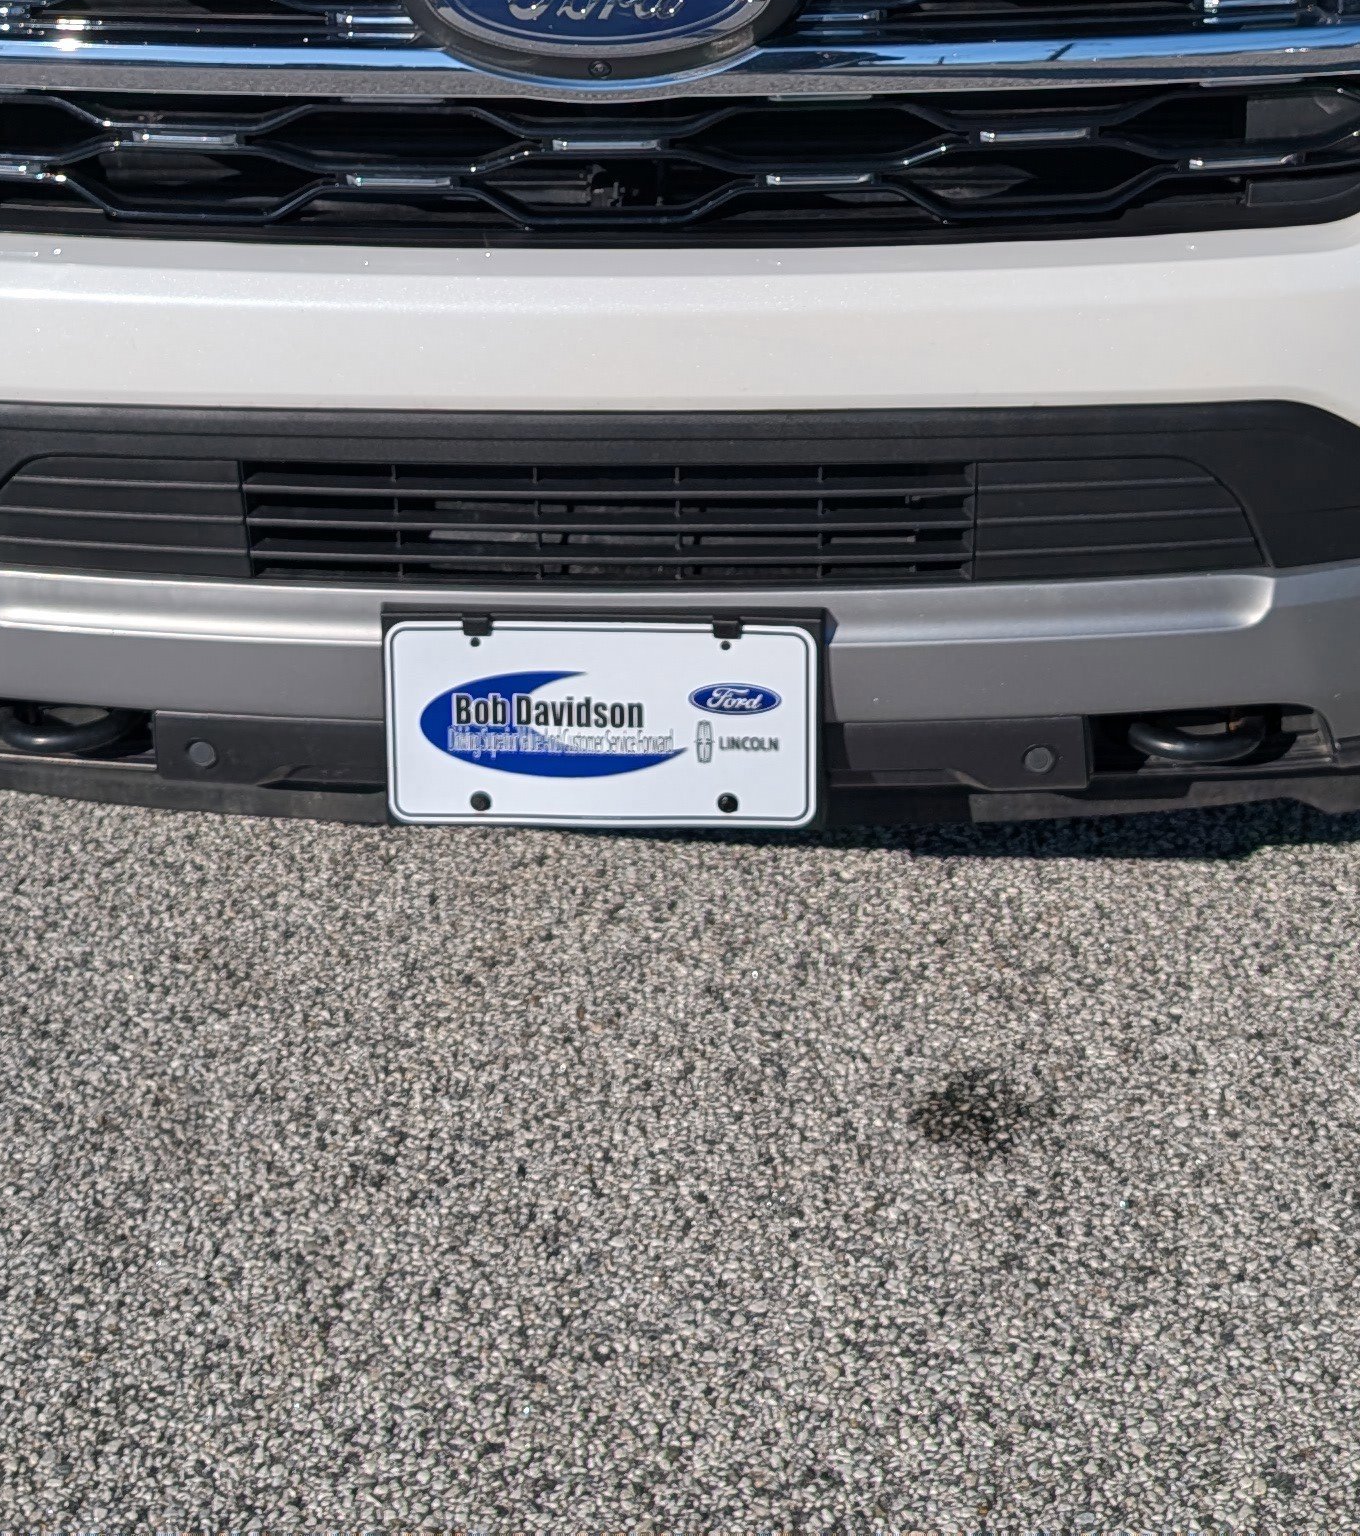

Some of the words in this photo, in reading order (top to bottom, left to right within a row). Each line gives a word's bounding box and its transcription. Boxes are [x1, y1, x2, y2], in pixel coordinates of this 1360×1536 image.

[706, 687, 764, 709] Ford
[455, 694, 508, 725] Bob
[515, 695, 645, 728] Davidson
[718, 736, 780, 752] LINCOLN
